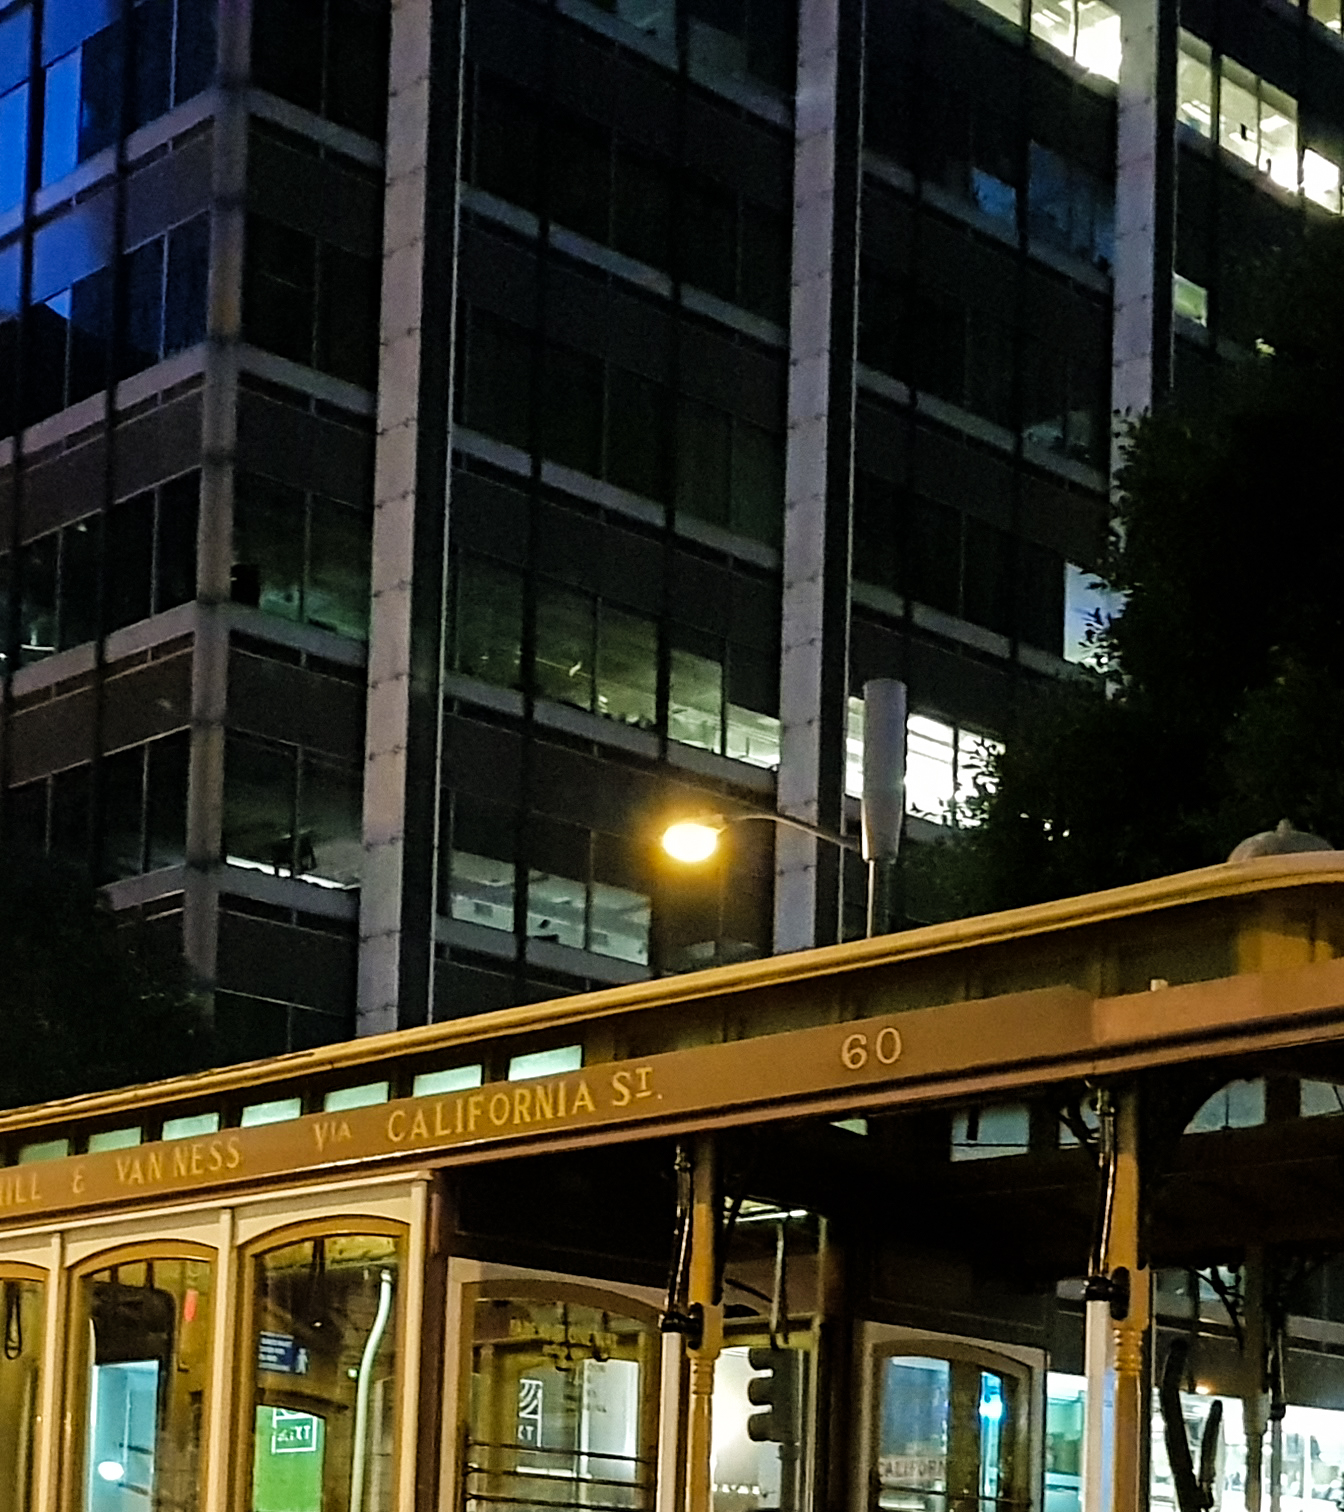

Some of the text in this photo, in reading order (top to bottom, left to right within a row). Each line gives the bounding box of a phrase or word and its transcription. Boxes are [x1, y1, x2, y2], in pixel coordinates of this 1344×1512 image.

[840, 1026, 903, 1070] 60
[312, 1117, 353, 1151] VIA
[386, 1075, 596, 1144] CALIFORNIA
[71, 1165, 86, 1194] &
[115, 1152, 163, 1185] VAN
[173, 1136, 243, 1177] NESS
